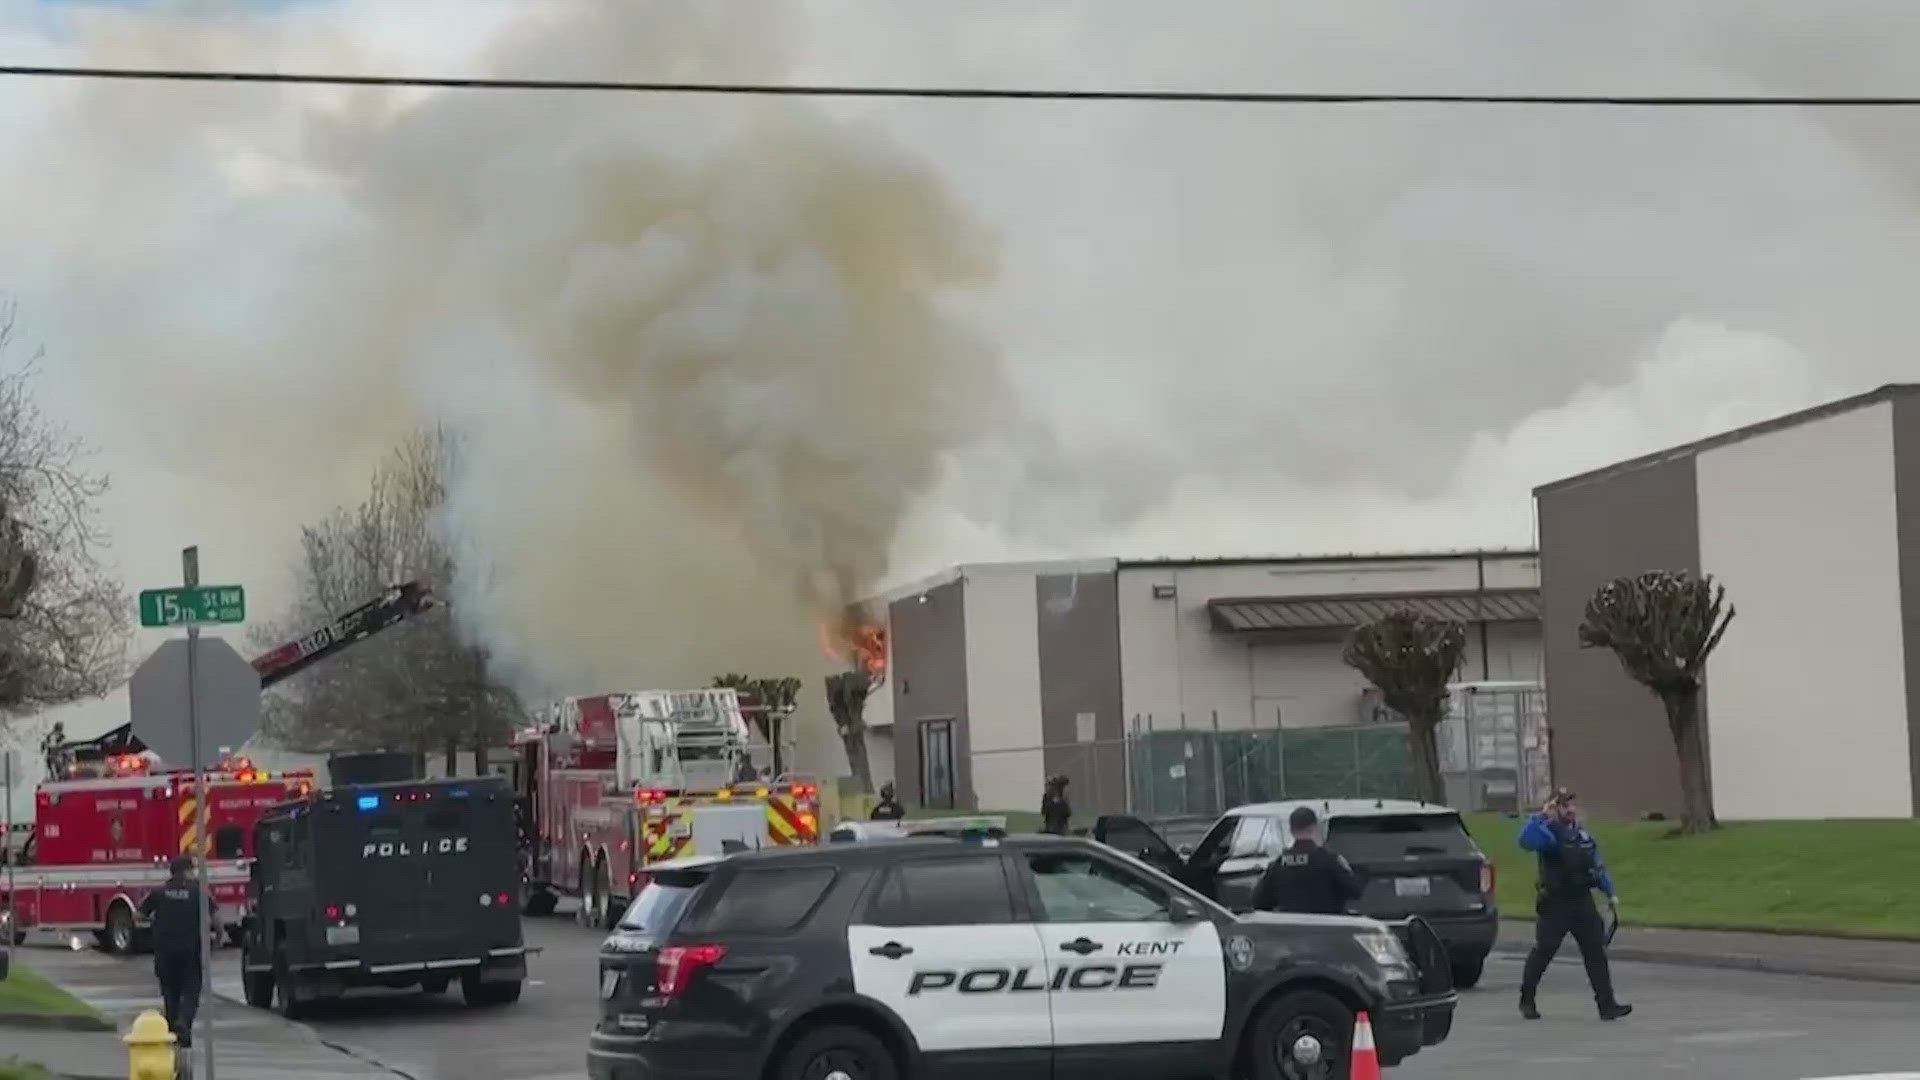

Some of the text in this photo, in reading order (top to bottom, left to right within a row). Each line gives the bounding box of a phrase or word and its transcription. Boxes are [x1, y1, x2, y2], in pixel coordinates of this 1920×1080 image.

[362, 837, 469, 859] POLICE
[1281, 853, 1309, 866] POLICE
[1117, 941, 1185, 957] KENT
[907, 964, 1163, 997] POLICE
